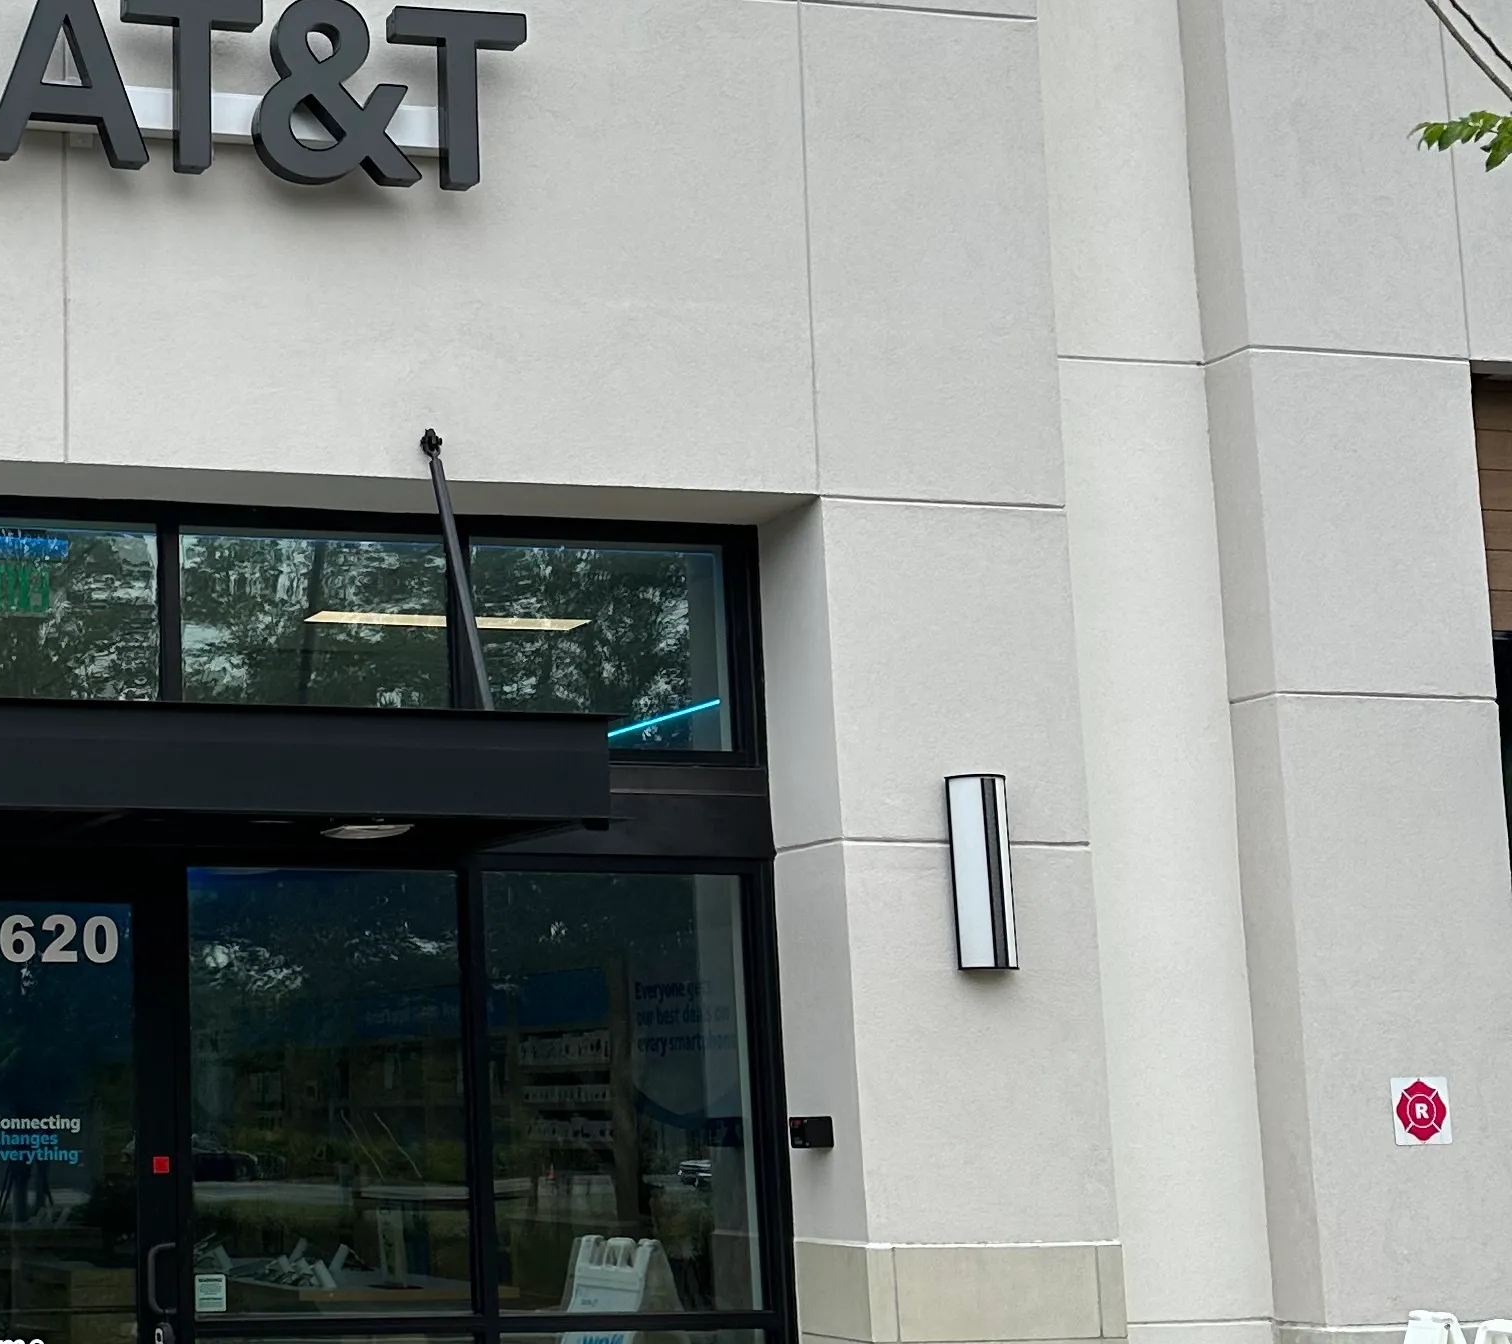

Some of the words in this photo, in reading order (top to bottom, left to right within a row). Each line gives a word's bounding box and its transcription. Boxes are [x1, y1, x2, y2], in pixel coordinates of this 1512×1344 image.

[634, 981, 686, 1004] Everyone
[636, 1010, 654, 1027] our
[656, 1006, 679, 1025] best
[1414, 1102, 1430, 1119] R
